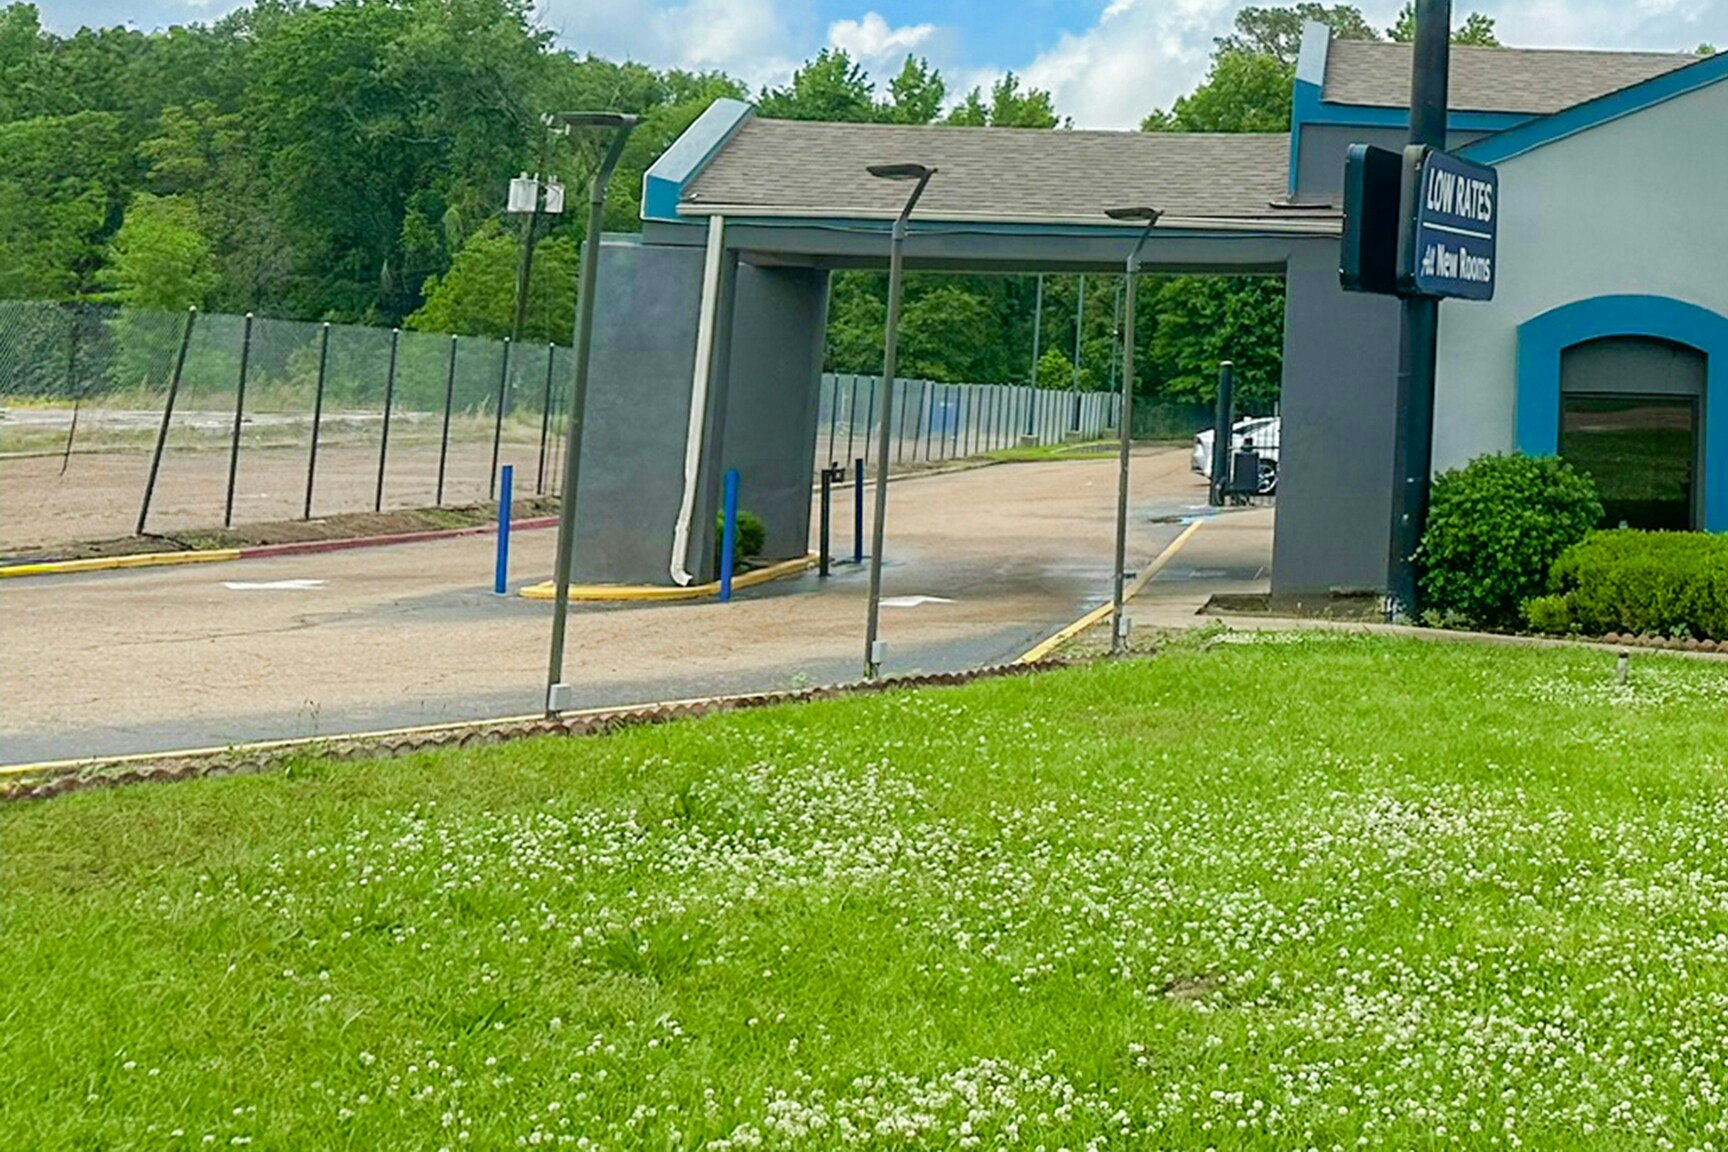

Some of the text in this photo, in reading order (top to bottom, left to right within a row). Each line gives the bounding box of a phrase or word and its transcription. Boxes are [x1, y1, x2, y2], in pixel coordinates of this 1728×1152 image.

[1427, 167, 1492, 223] LOW RATES
[1436, 243, 1459, 279] New
[1459, 246, 1491, 283] Rooms
